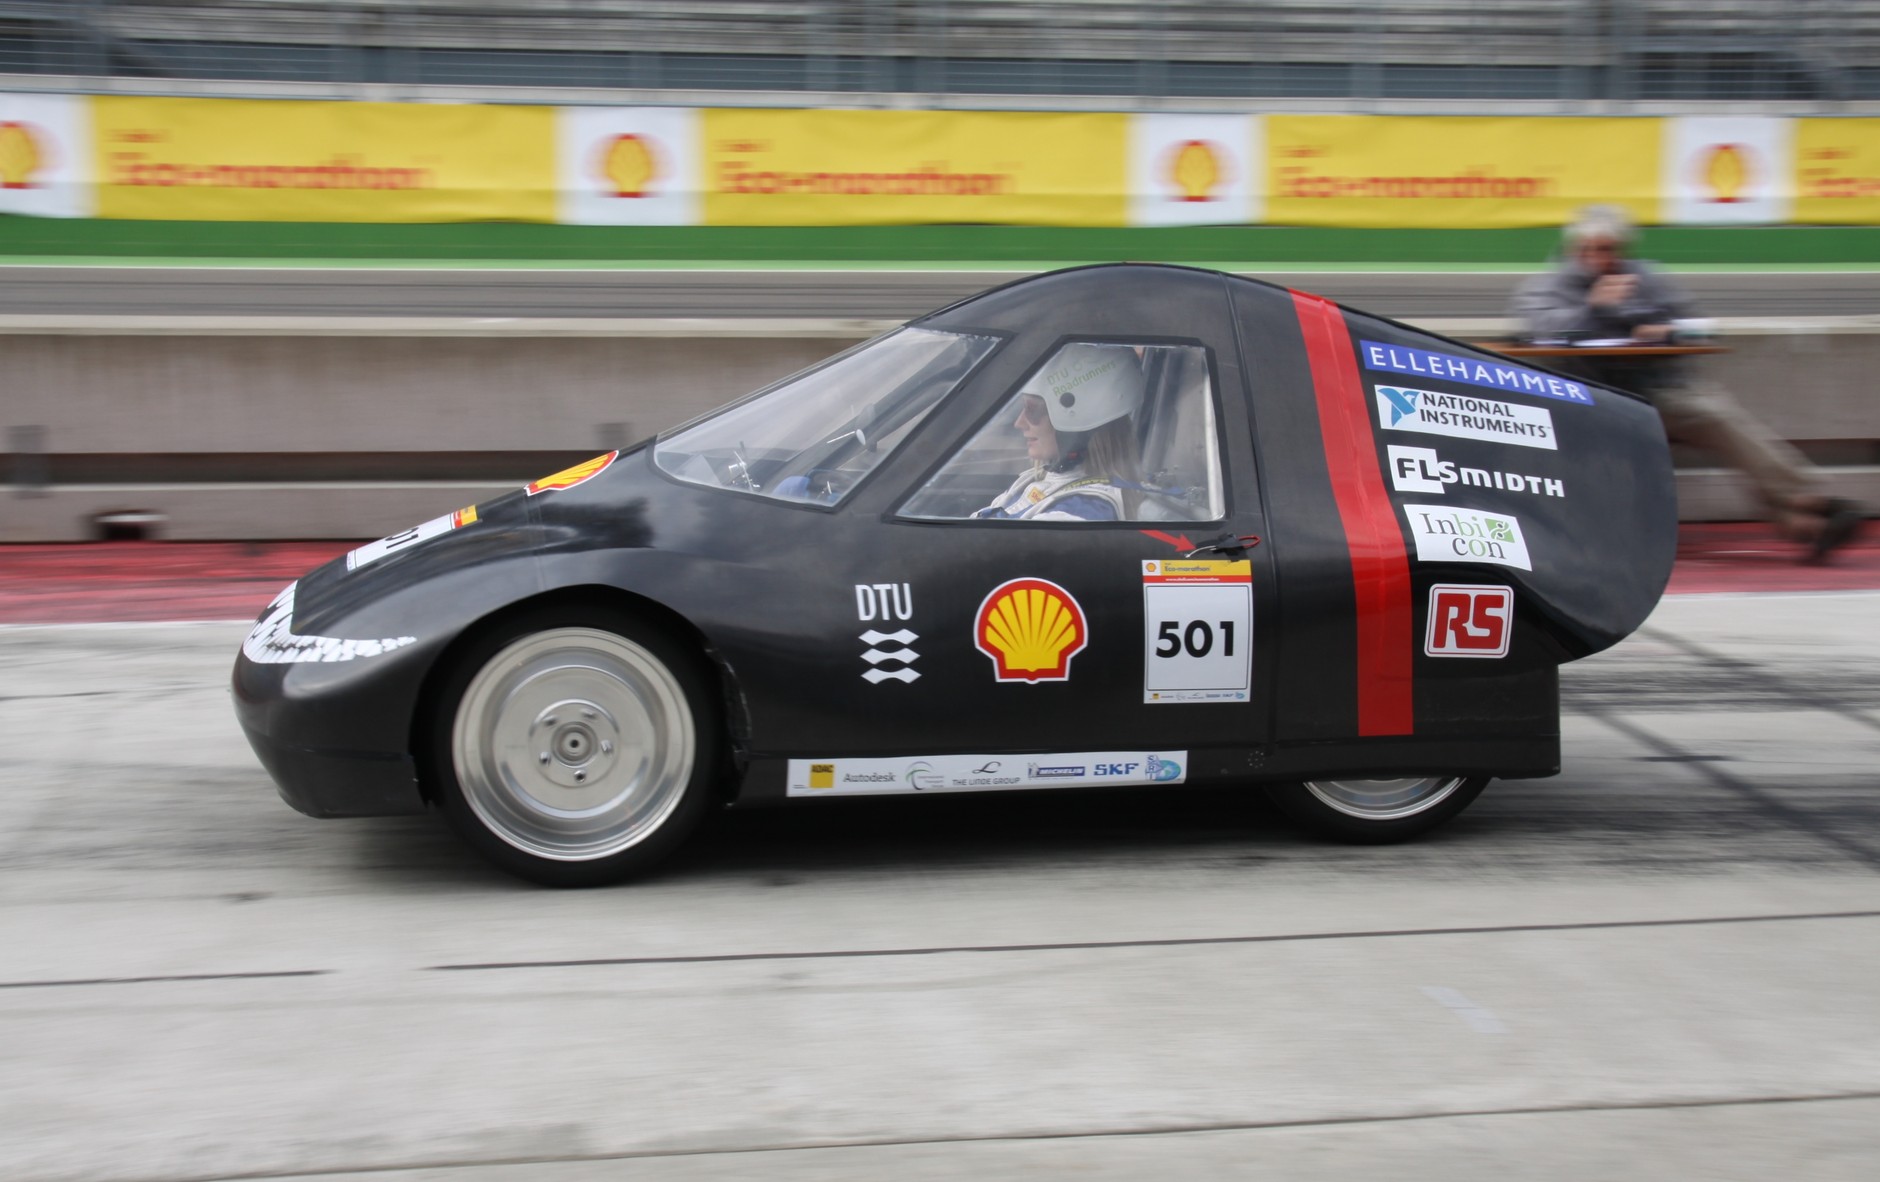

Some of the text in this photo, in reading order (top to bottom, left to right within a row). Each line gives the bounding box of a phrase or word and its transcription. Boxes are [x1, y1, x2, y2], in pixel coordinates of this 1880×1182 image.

[1046, 367, 1070, 386] DTU
[1052, 360, 1117, 397] Roadrunners
[1368, 345, 1588, 401] ELLEHAMMER
[1422, 391, 1516, 418] NATIONAL
[1419, 408, 1548, 439] INSTRUMENTS
[854, 582, 914, 621] DTU
[1432, 592, 1505, 650] RS
[1155, 619, 1235, 659] 501
[843, 771, 896, 783] Autodesk
[992, 777, 1020, 785] GROUP
[1093, 762, 1139, 776] SKF
